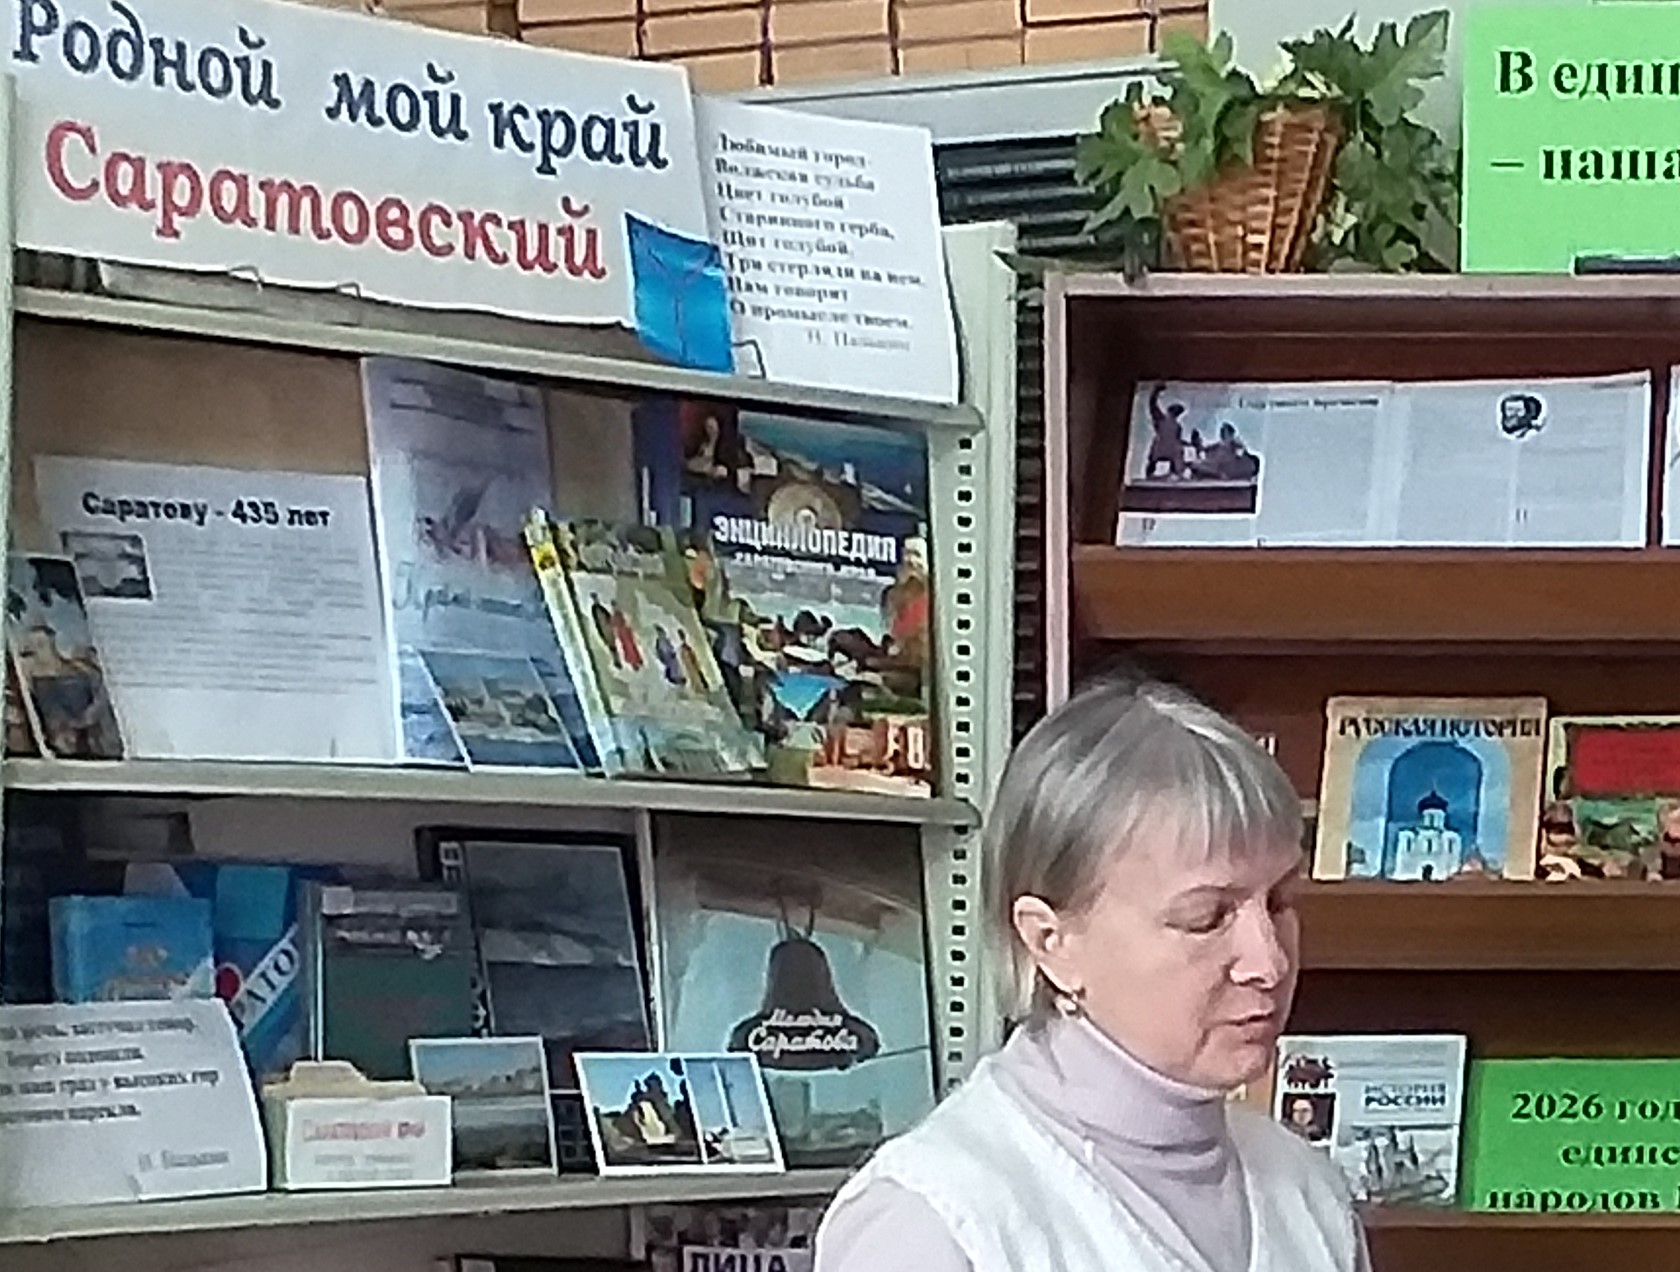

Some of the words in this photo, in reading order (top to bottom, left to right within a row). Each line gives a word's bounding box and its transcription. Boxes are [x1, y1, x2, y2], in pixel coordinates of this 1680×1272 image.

[12, 0, 282, 109] Родной
[326, 63, 469, 141] мой
[488, 94, 669, 175] край
[1498, 50, 1534, 95] В
[720, 132, 808, 161] Любимый
[45, 120, 607, 280] Саратовский
[82, 491, 208, 526] Саратову
[231, 497, 280, 525] 435
[287, 507, 331, 527] лет
[713, 515, 897, 564] ЭНЦИКЛОПЕДИЯ
[1365, 1083, 1446, 1095] ИСТОРИЯ
[1365, 1095, 1446, 1108] РОССИИ
[1511, 1093, 1604, 1121] 2026
[1487, 1189, 1661, 1212] народов
